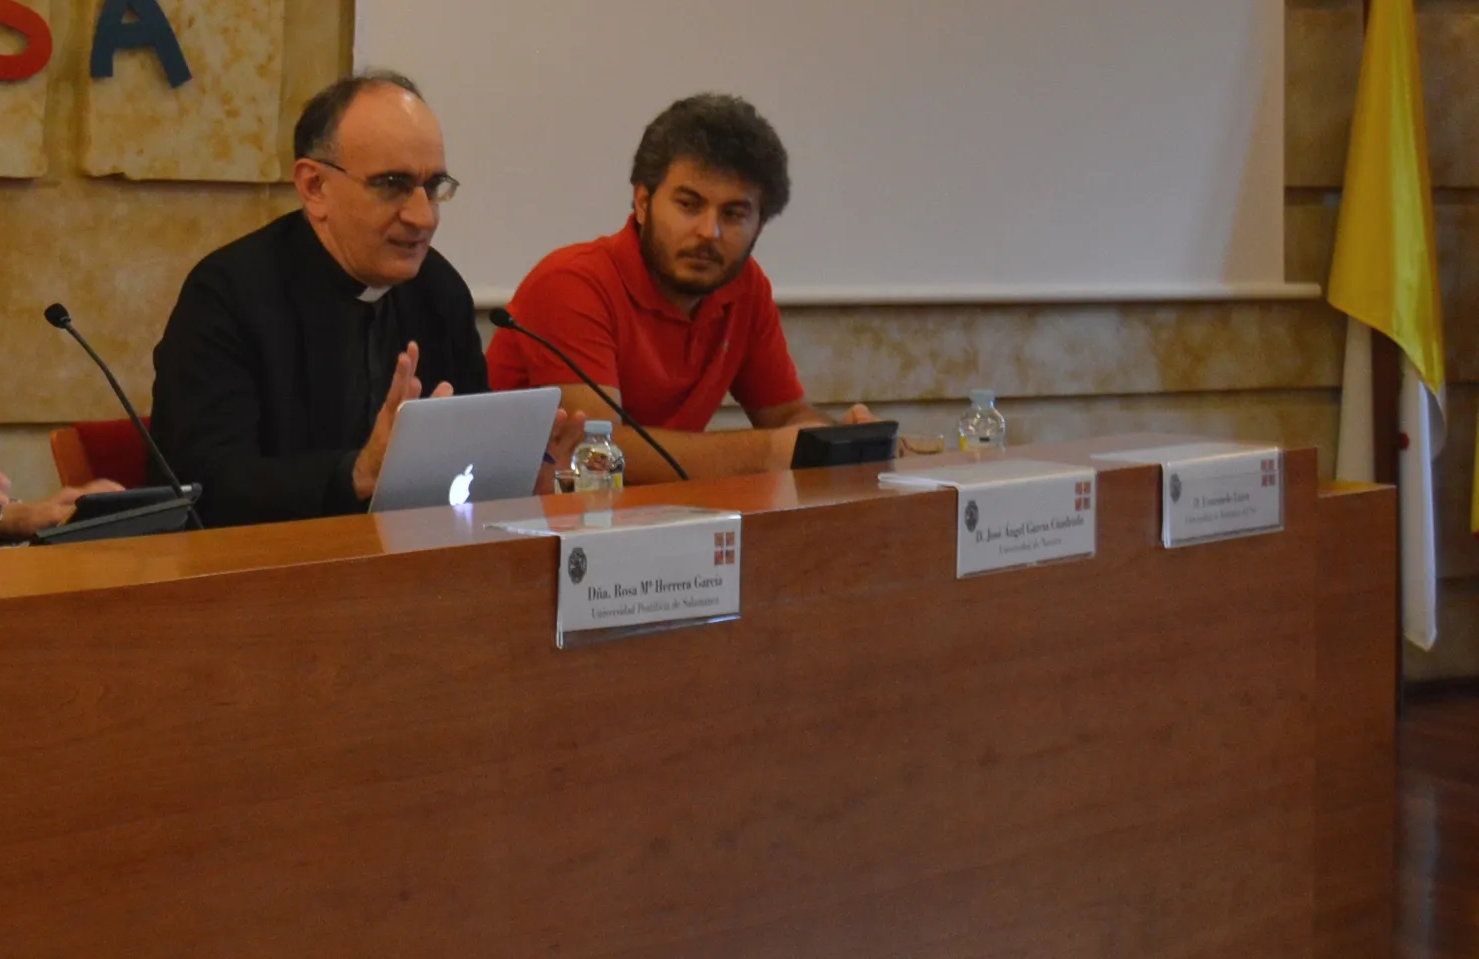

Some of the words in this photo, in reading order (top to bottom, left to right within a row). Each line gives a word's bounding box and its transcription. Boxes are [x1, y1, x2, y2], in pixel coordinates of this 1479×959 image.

[613, 583, 638, 599] Rosa
[655, 578, 692, 595] Herrera
[693, 574, 723, 590] García
